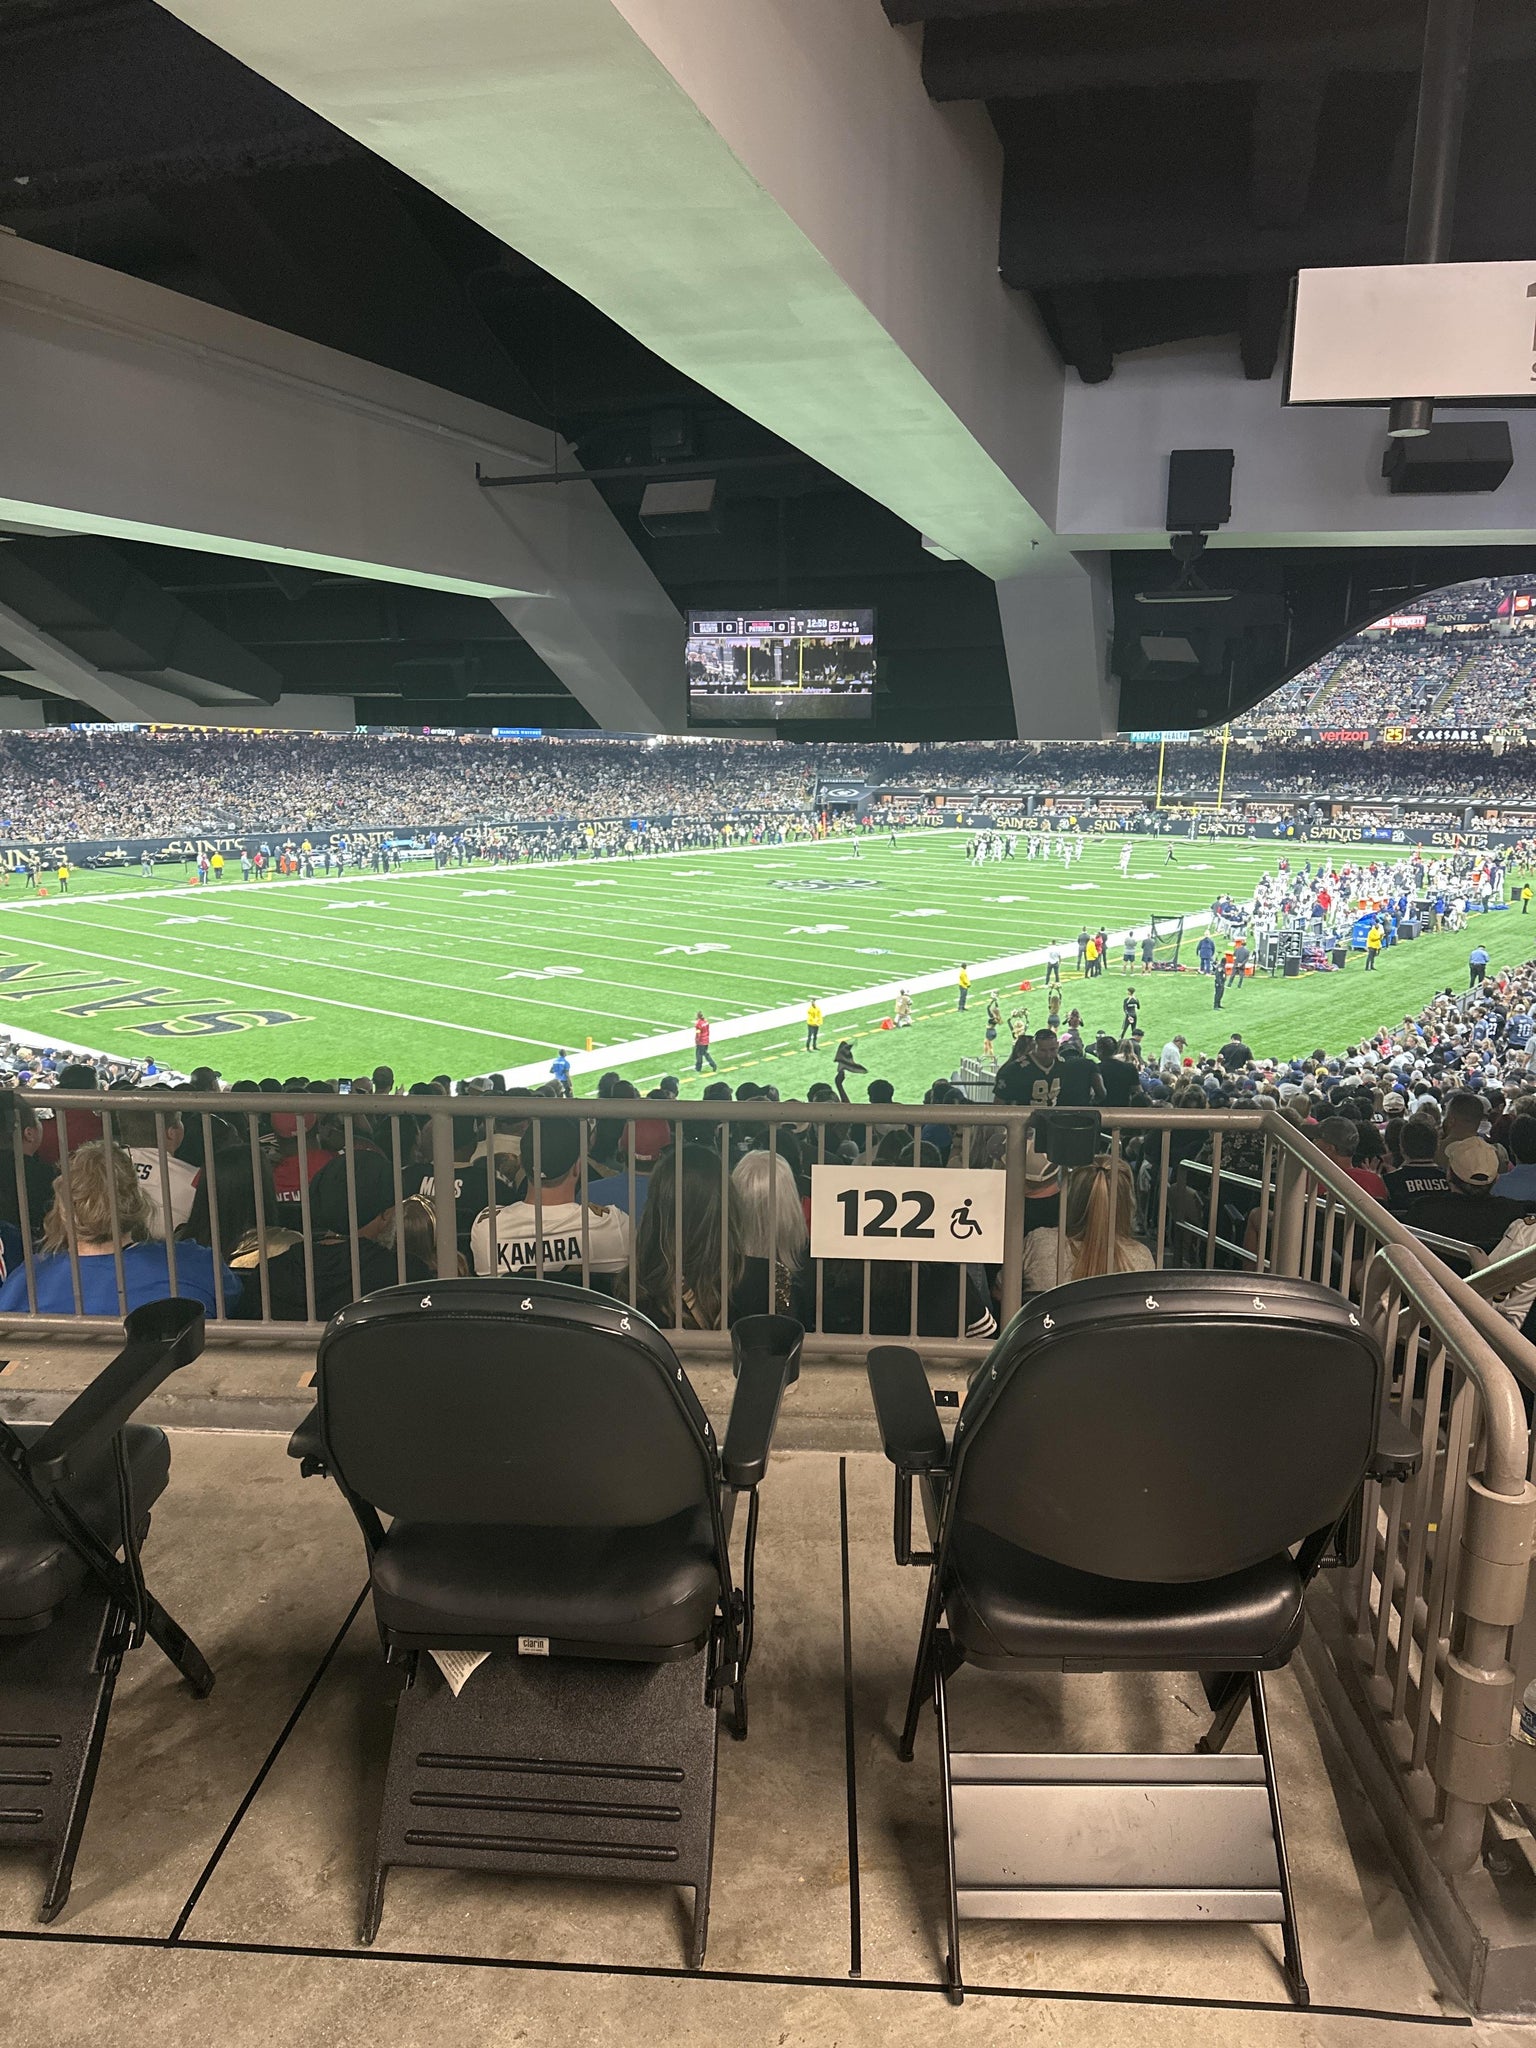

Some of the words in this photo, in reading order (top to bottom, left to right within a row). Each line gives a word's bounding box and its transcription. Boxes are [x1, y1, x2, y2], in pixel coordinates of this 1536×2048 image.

[1436, 614, 1467, 622] SAINTS
[726, 624, 733, 632] 0
[778, 623, 786, 631] 0
[384, 725, 410, 733] SAINTS
[430, 728, 455, 736] entergy
[1203, 729, 1232, 737] SAINTS
[1267, 729, 1297, 737] SAINTS
[1489, 728, 1524, 736] SAINTS
[1319, 729, 1369, 742] verizon
[1386, 729, 1403, 741] 25
[1417, 730, 1478, 741] CAESARS
[1517, 1023, 1532, 1037] 10
[837, 1189, 936, 1239] 122
[497, 1236, 583, 1266] KAMARA
[522, 1638, 545, 1649] clarin
